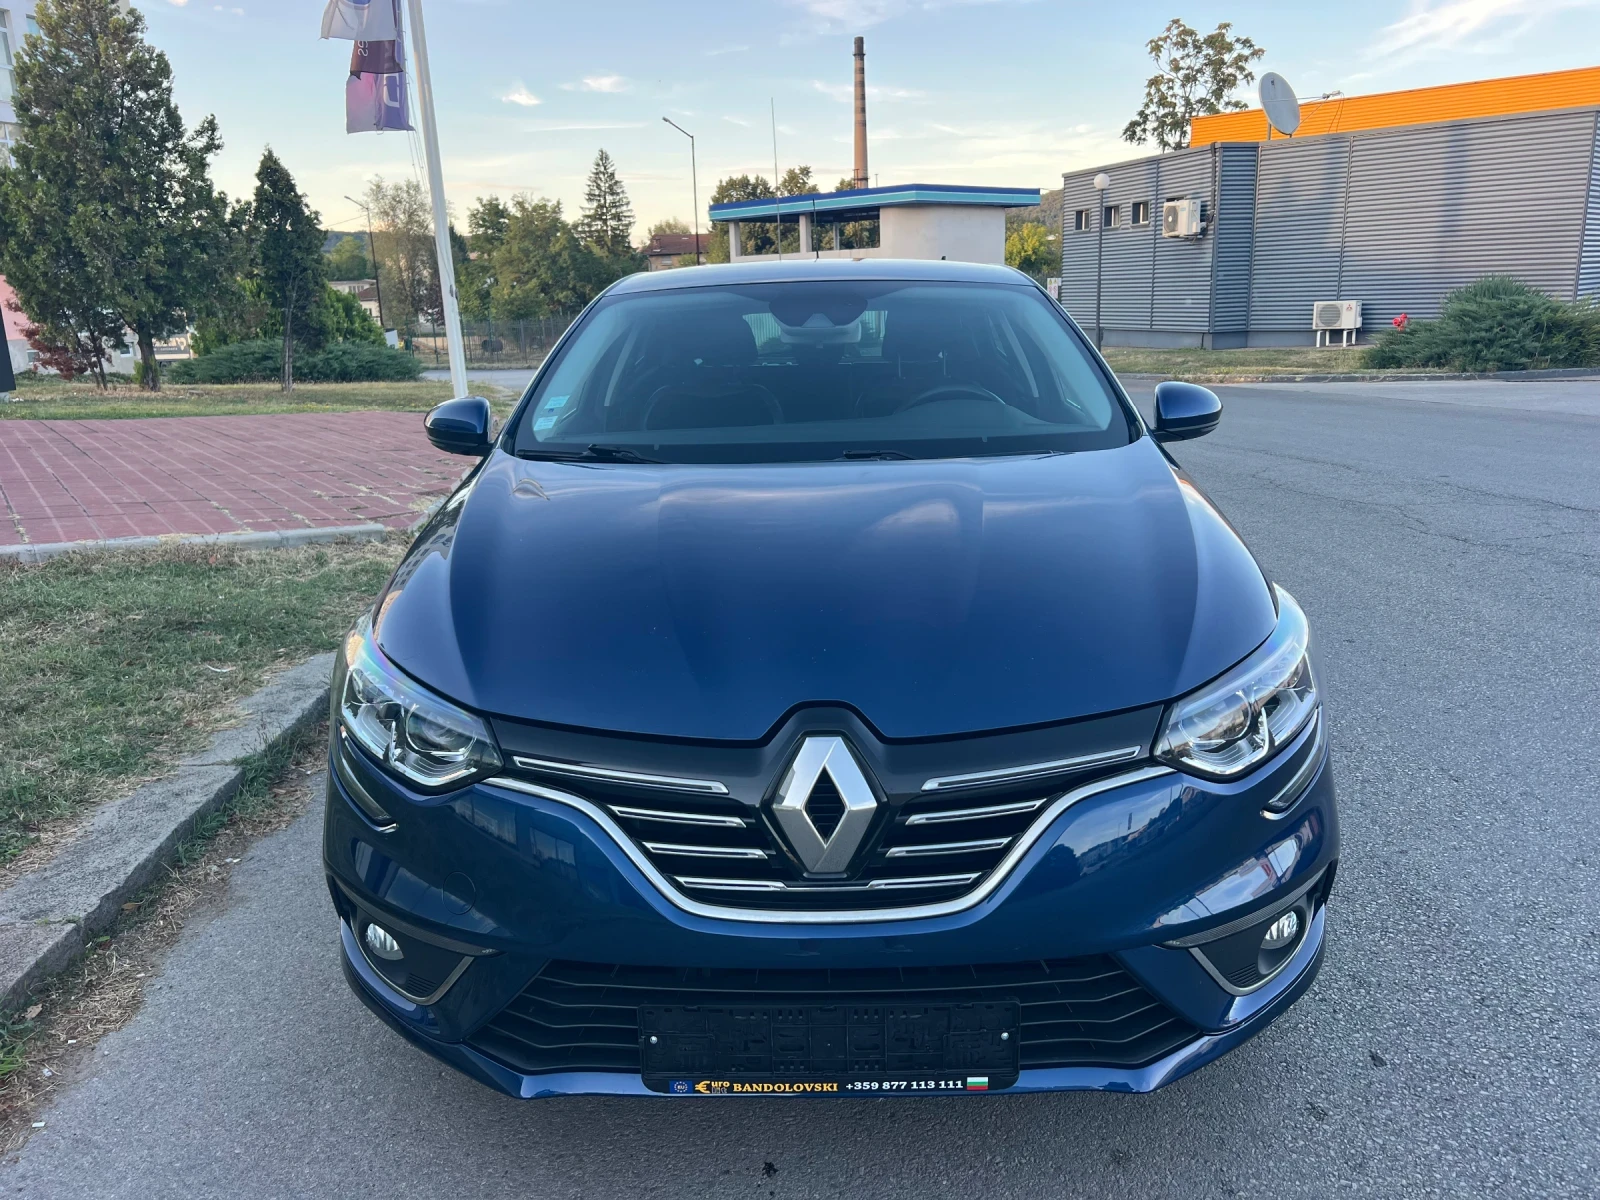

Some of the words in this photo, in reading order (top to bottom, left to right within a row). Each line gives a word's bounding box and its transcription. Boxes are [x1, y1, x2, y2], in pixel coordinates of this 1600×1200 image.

[732, 1082, 838, 1092] BANDOLOVSKI
[845, 1081, 879, 1090] +359
[882, 1081, 908, 1090] 877
[910, 1080, 936, 1090] 113
[938, 1079, 964, 1089] 111
